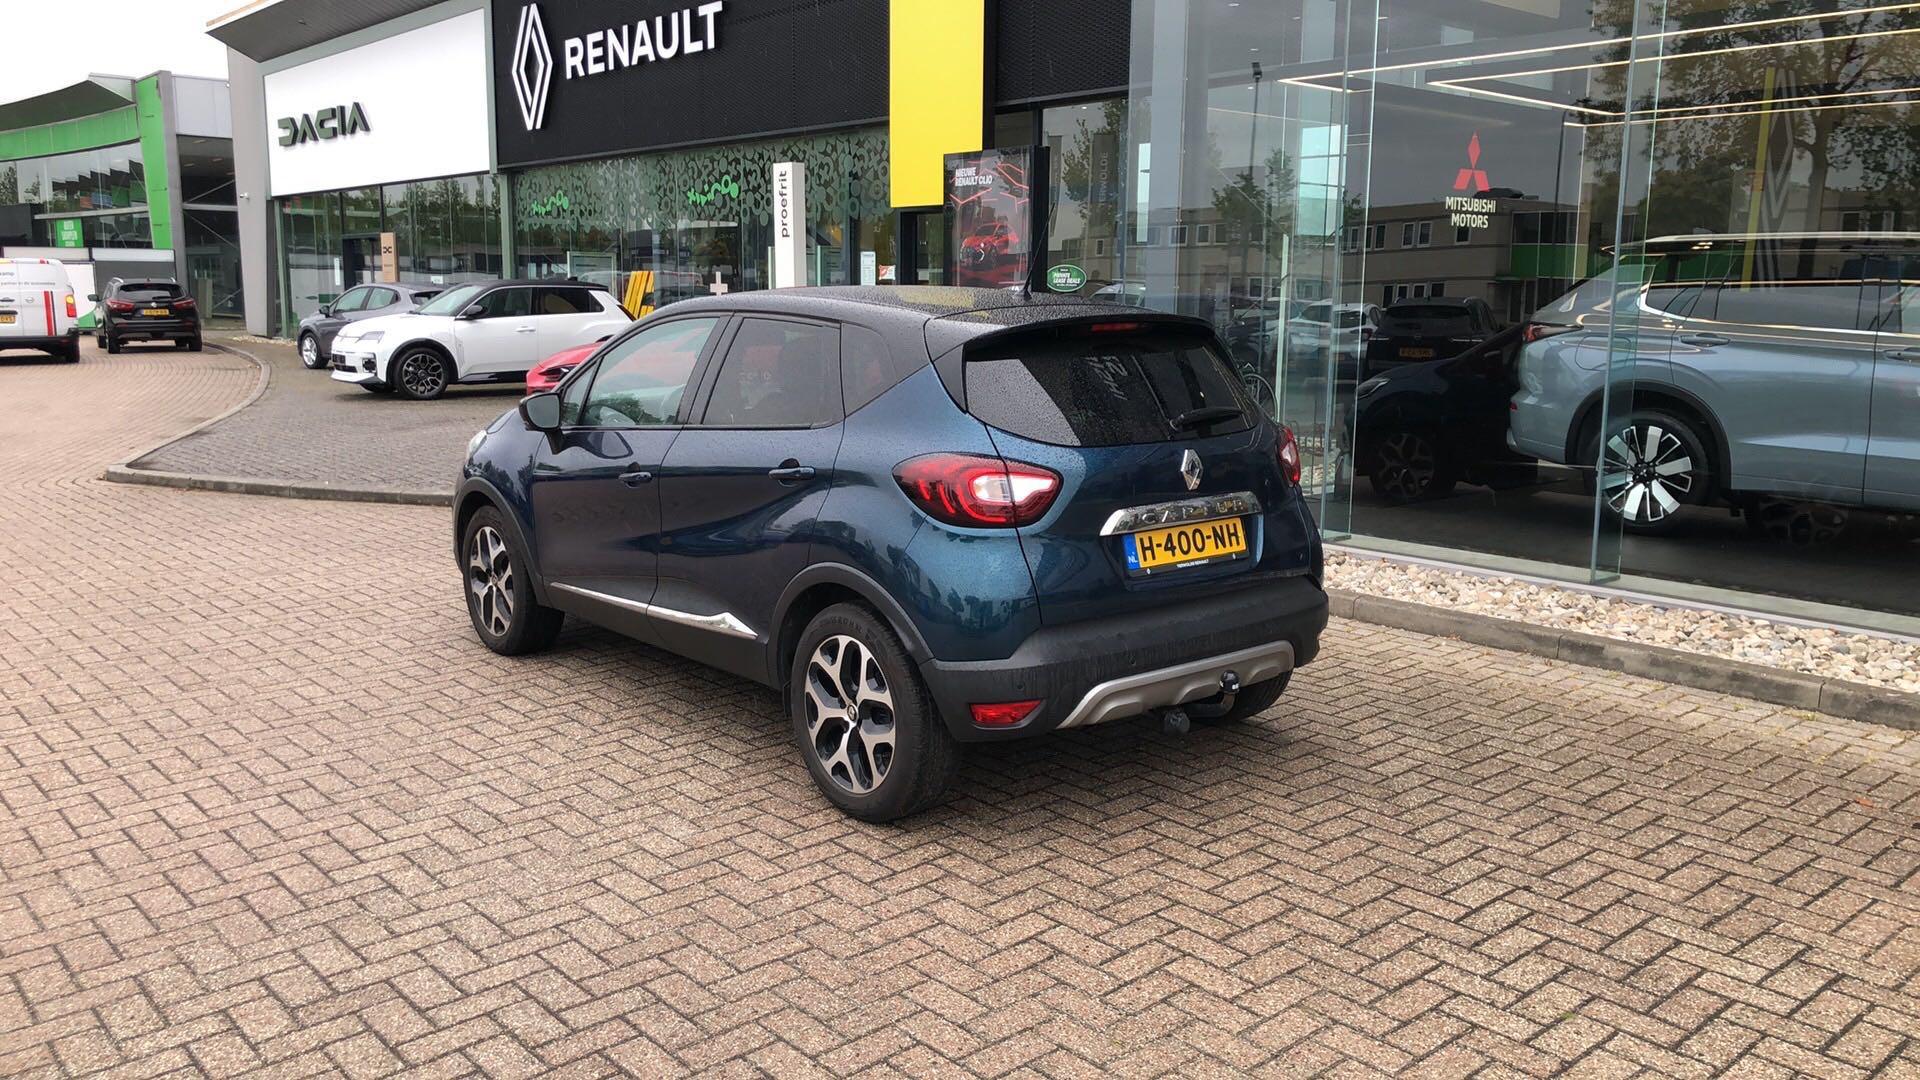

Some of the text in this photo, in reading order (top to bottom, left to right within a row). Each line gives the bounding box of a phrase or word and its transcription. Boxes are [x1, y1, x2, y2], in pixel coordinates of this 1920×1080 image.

[564, 0, 723, 80] RENAULT
[277, 101, 371, 148] DACIA
[955, 167, 977, 177] NIEUWE
[955, 174, 993, 187] RENAULT CLIO
[779, 170, 790, 238] proefrit
[1445, 196, 1496, 213] MITSUBISHI
[1451, 213, 1489, 228] MOTORS
[1139, 523, 1240, 562] H-400-NH
[1128, 554, 1139, 564] NL
